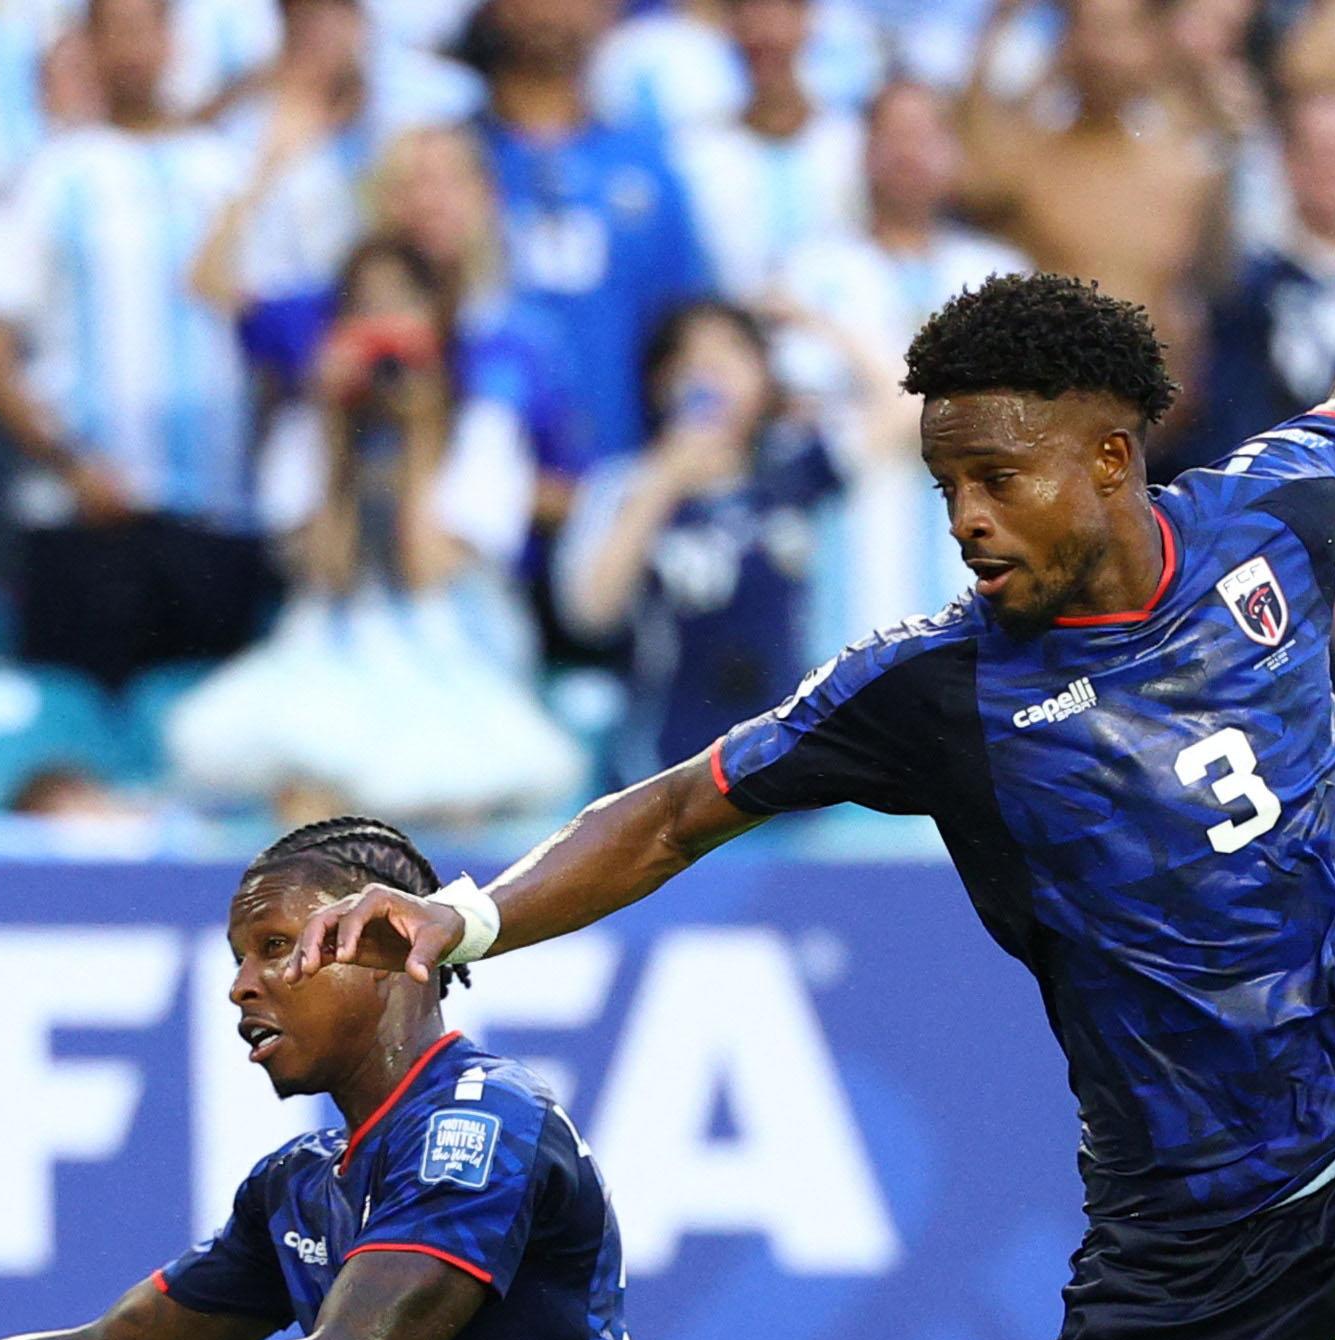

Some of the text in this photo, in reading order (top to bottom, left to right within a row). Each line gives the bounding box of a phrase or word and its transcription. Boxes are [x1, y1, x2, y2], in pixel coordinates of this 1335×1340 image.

[1222, 562, 1261, 593] FCF
[1012, 676, 1097, 728] capelli
[1174, 727, 1282, 854] 3
[436, 1130, 486, 1152] UNITES
